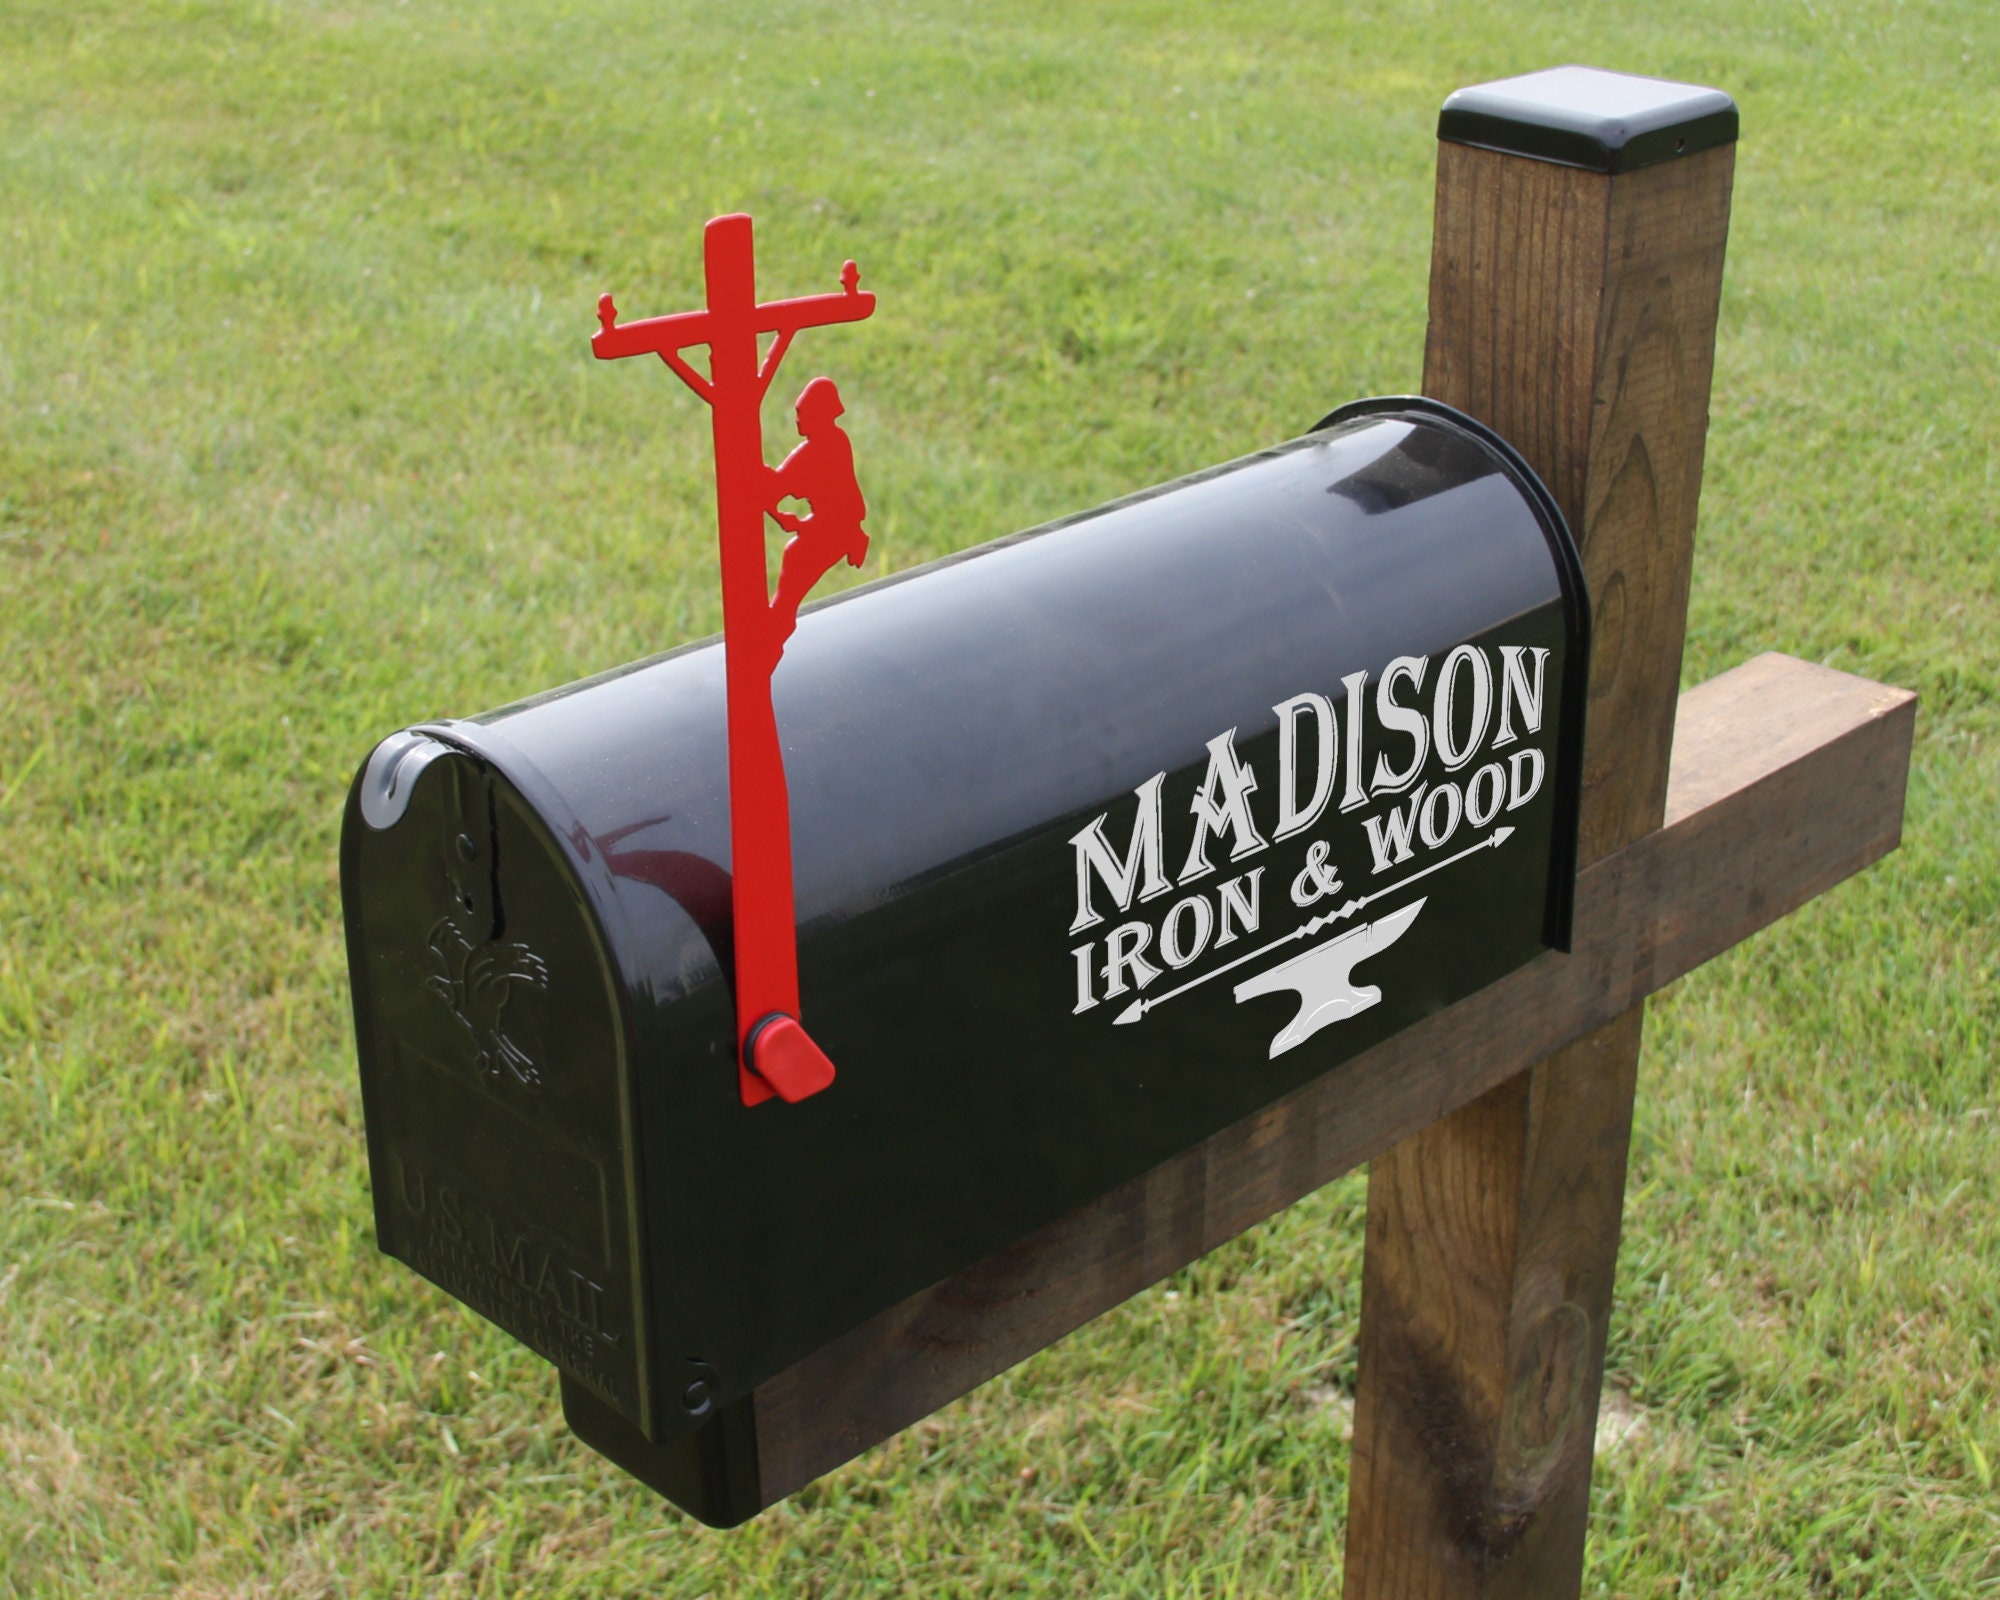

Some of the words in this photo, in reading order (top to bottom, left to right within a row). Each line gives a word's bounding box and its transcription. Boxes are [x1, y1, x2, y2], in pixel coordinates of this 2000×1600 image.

[1068, 644, 1551, 937] MADISON
[1071, 866, 1266, 1015] IRON
[1290, 840, 1344, 907] &
[1361, 748, 1545, 875] WOOD
[484, 1211, 623, 1353] MAIL
